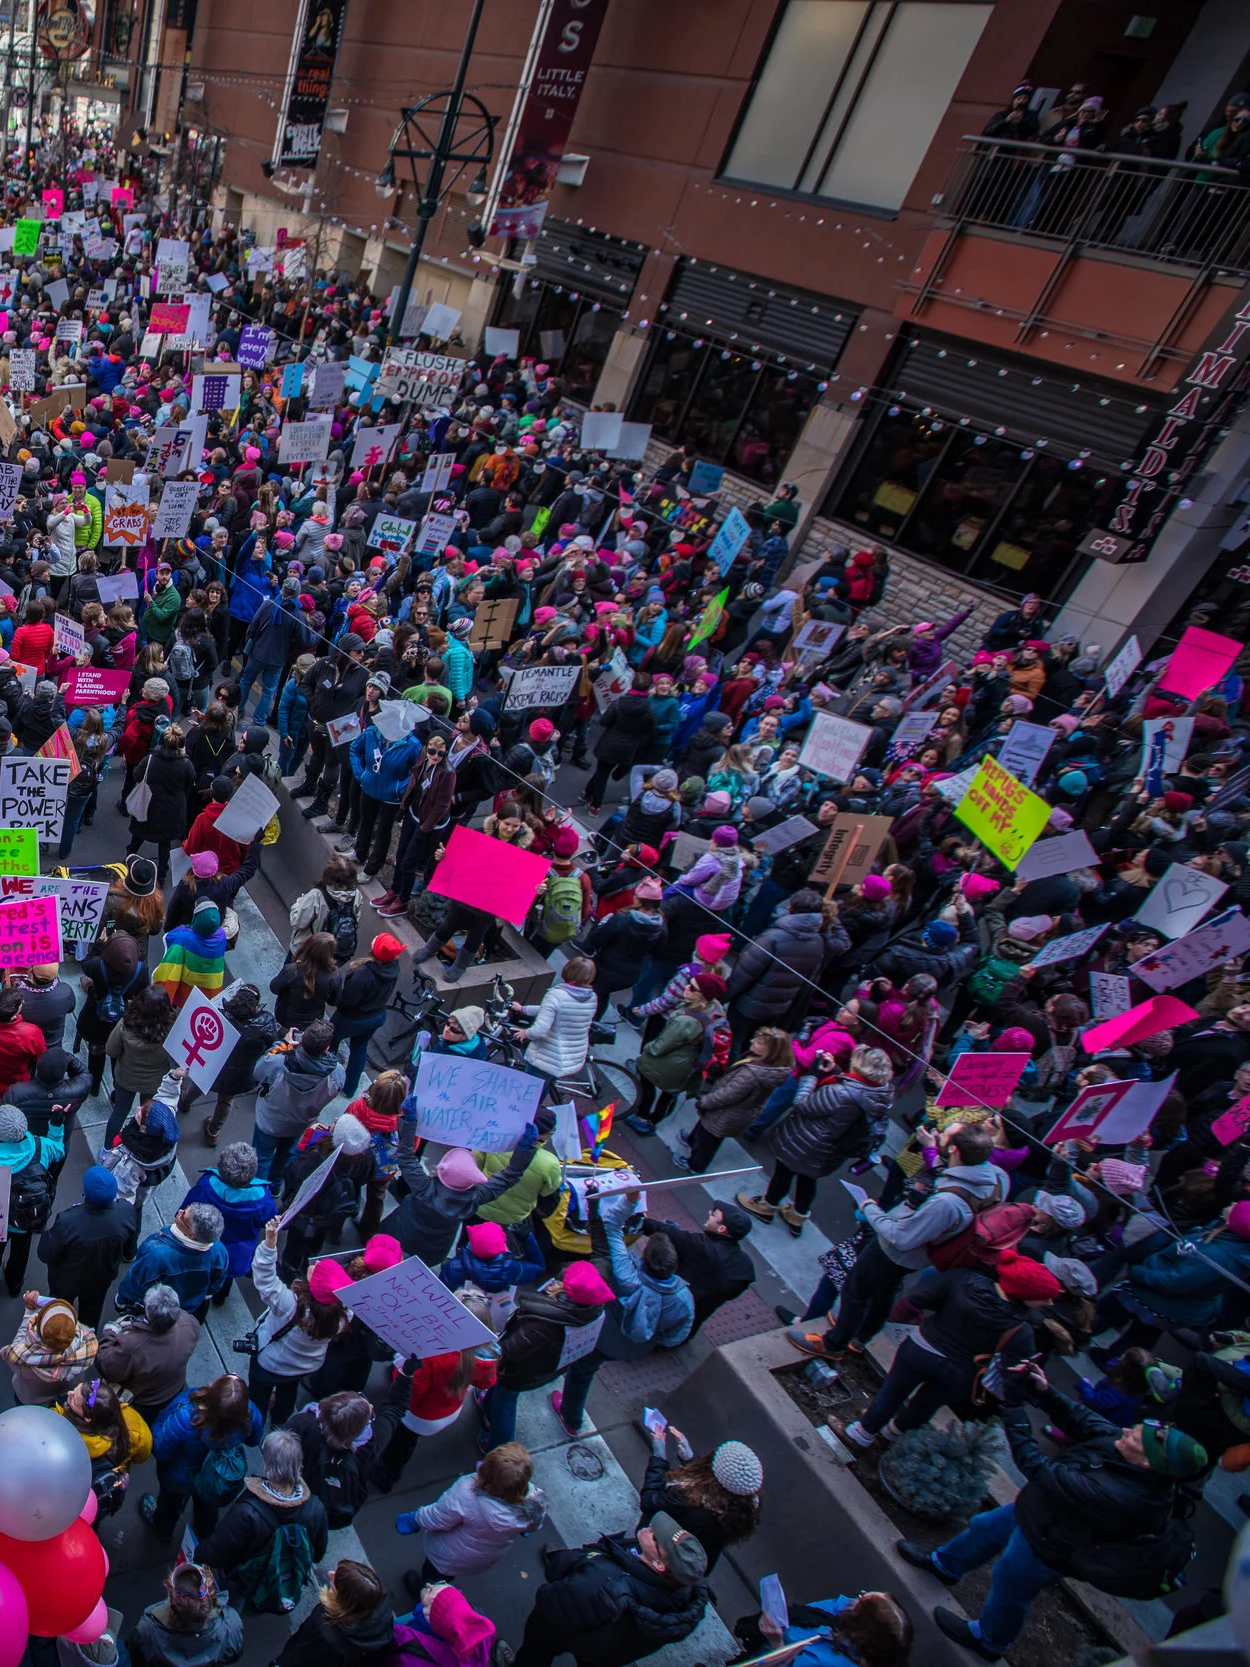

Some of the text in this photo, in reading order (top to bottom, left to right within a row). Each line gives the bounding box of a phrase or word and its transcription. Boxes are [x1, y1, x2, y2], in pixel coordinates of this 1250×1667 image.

[536, 68, 584, 83] LITTLE
[297, 80, 327, 98] thing
[244, 327, 269, 339] I'm
[240, 342, 268, 360] every
[404, 351, 459, 372] FLUSH
[385, 363, 461, 386] EMPEROR
[397, 380, 458, 406] DUMP
[1108, 300, 1250, 535] IMALDI'S
[286, 451, 322, 460] EVERYONE
[112, 518, 142, 528] GRABS
[57, 631, 81, 650] KIND
[521, 666, 574, 681] DISMANTLE
[75, 688, 117, 696] PARENTHOOD
[540, 689, 570, 703] RACISM
[6, 760, 70, 787] TAKE
[981, 758, 1028, 806] REPUGS
[16, 785, 46, 798] THE
[1, 798, 66, 819] POWER
[968, 788, 1012, 835] OFF MY
[9, 820, 60, 838] BACK
[815, 828, 850, 876] Integrity
[0, 858, 31, 872] the
[1, 876, 101, 897] WE ARE THE
[61, 917, 99, 941] BERTY
[427, 1063, 542, 1104] WE SHARE
[420, 1104, 473, 1134] WATER
[385, 1276, 423, 1307] NOT
[421, 1313, 456, 1337] BE
[405, 1267, 468, 1331] I WILL
